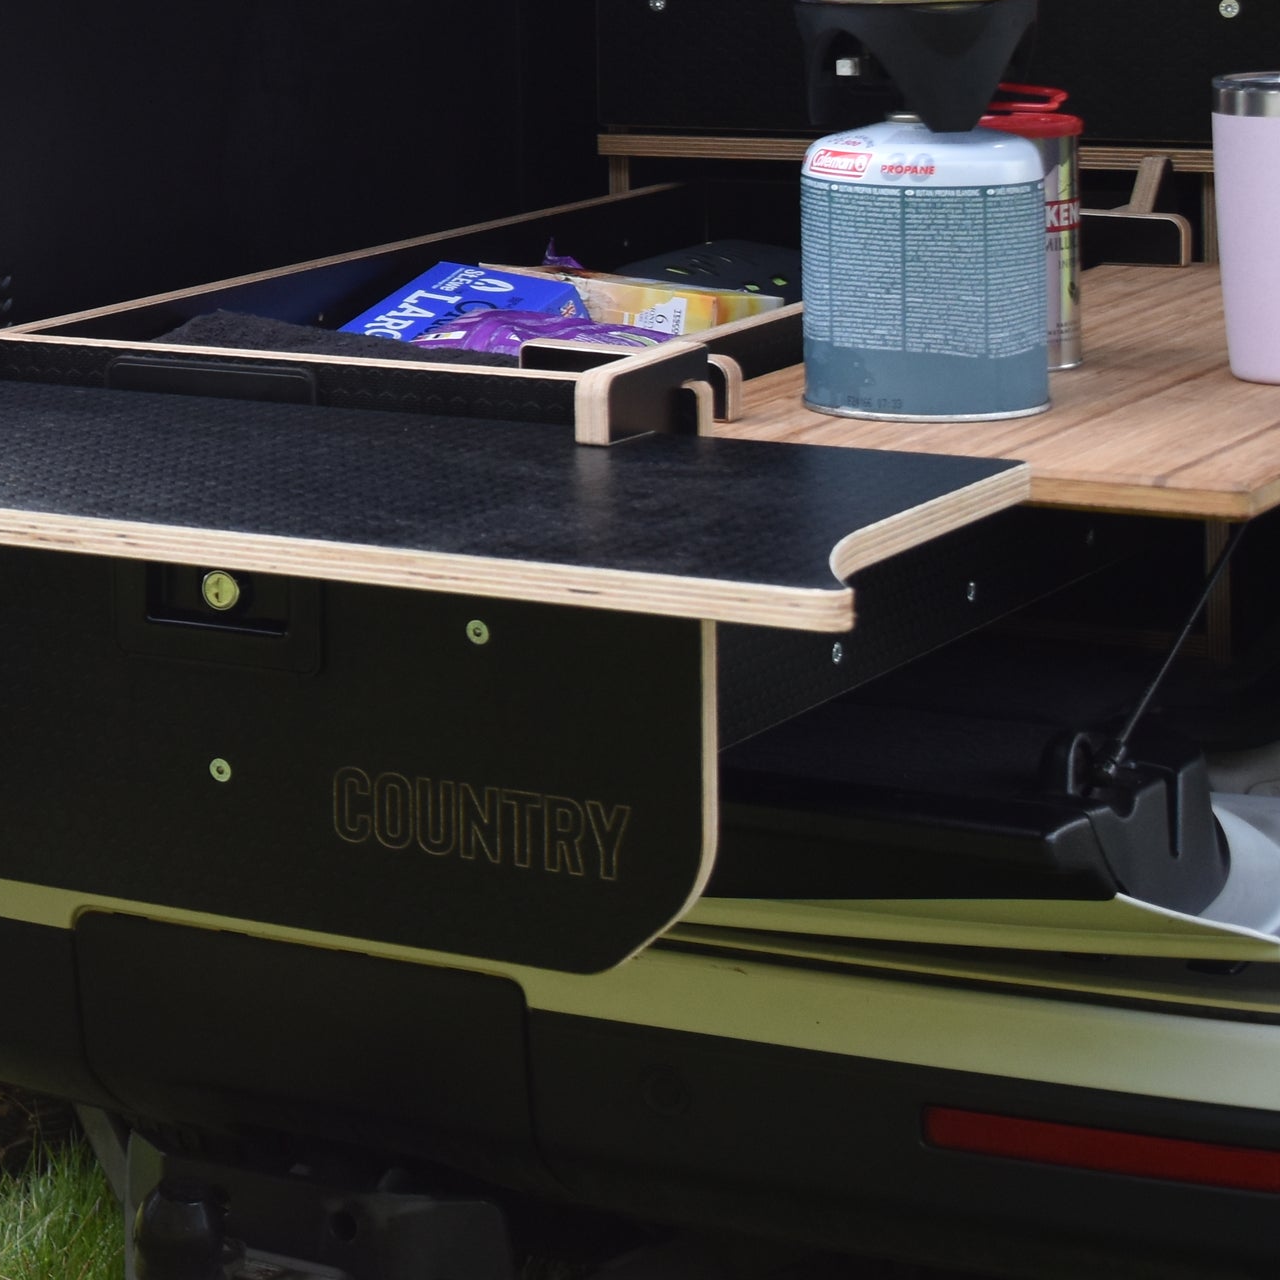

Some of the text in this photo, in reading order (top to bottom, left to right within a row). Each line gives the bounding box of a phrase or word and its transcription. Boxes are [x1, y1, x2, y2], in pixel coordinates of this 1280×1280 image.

[813, 150, 853, 171] Coleman
[880, 164, 936, 175] PROPANE
[655, 314, 668, 324] 6
[672, 309, 681, 335] TESCO
[333, 766, 632, 881] COUNTRY
